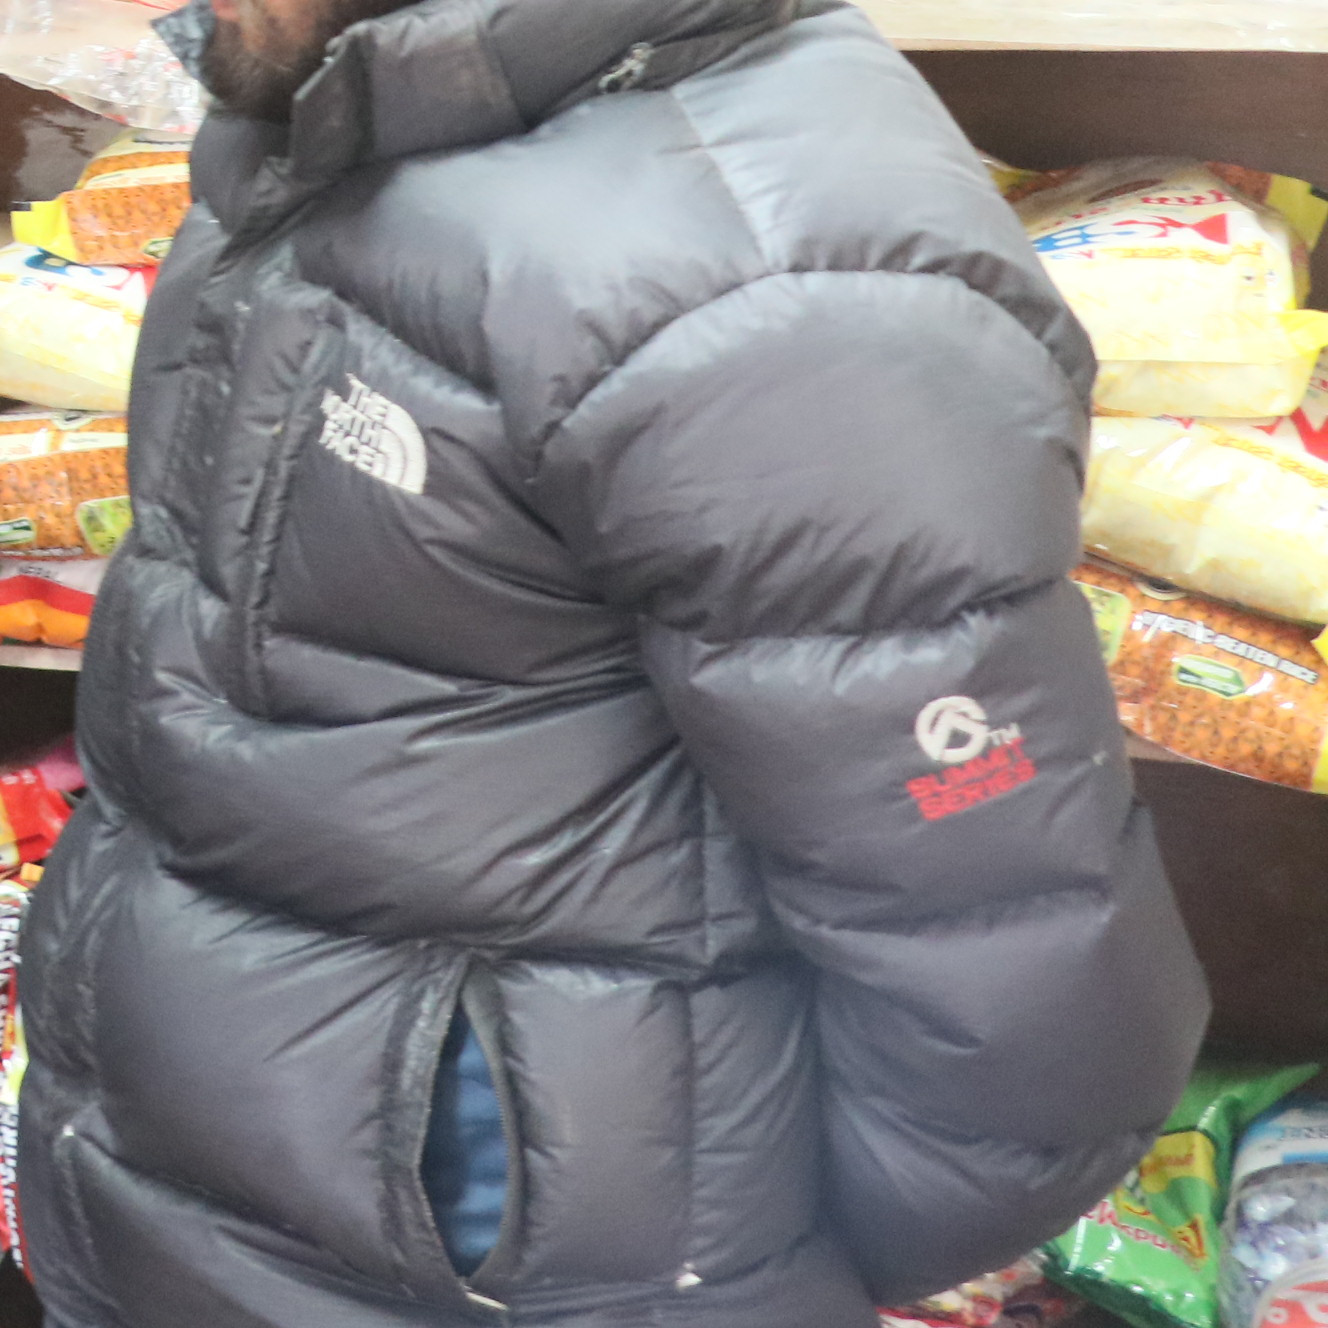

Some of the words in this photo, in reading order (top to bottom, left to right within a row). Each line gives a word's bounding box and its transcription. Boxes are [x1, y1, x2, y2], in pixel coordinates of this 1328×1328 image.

[320, 388, 383, 449] NORTH
[344, 372, 393, 423] THE
[318, 420, 387, 480] FACE
